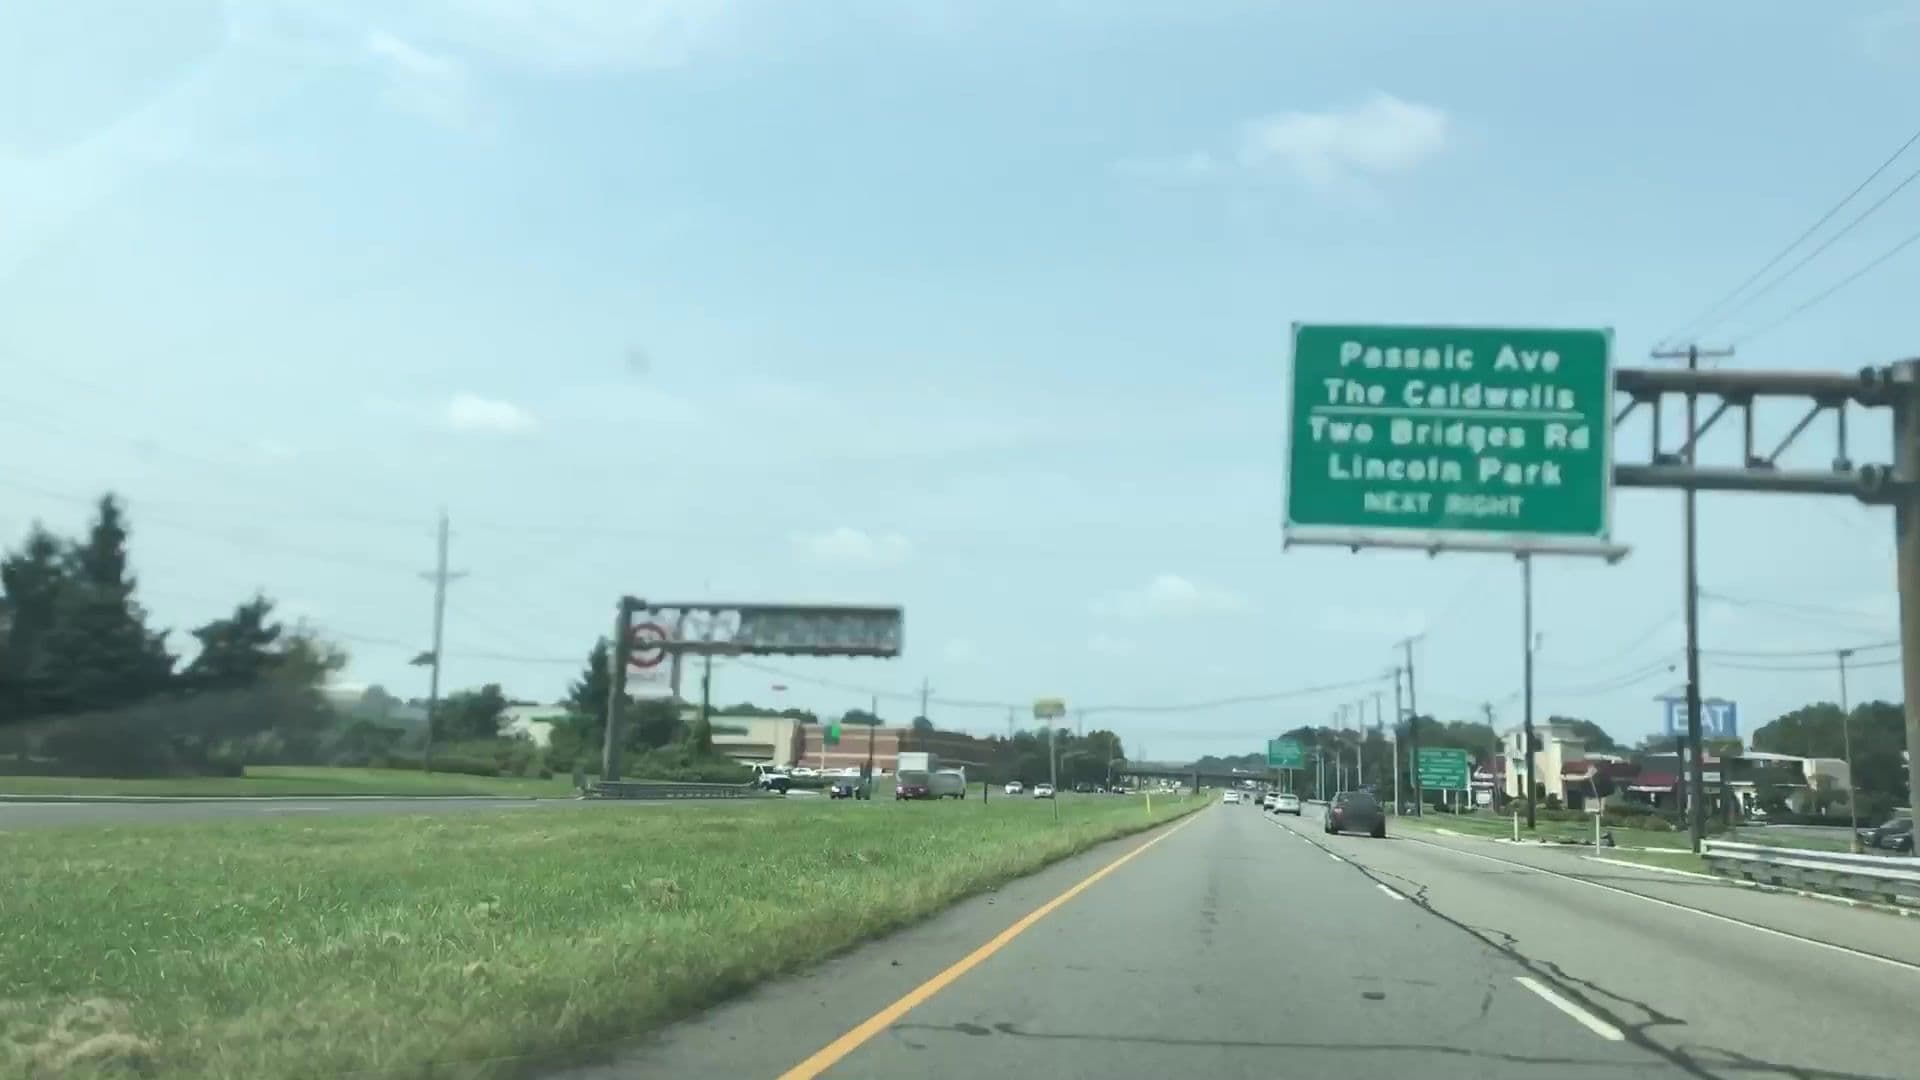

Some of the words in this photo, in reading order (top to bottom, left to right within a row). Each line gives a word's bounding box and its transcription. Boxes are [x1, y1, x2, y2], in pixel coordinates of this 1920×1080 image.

[1340, 341, 1474, 370] Passaic
[1494, 345, 1560, 372] Ave
[1324, 379, 1386, 405] The
[1403, 380, 1575, 409] Caldwells
[1309, 416, 1374, 444] Two
[1390, 418, 1525, 453] Bridges
[1544, 423, 1590, 450] Rd
[1328, 453, 1462, 482] Lincoln
[1480, 457, 1561, 485] Park
[1364, 491, 1432, 514] NEXT
[1445, 493, 1525, 518] RIGHT
